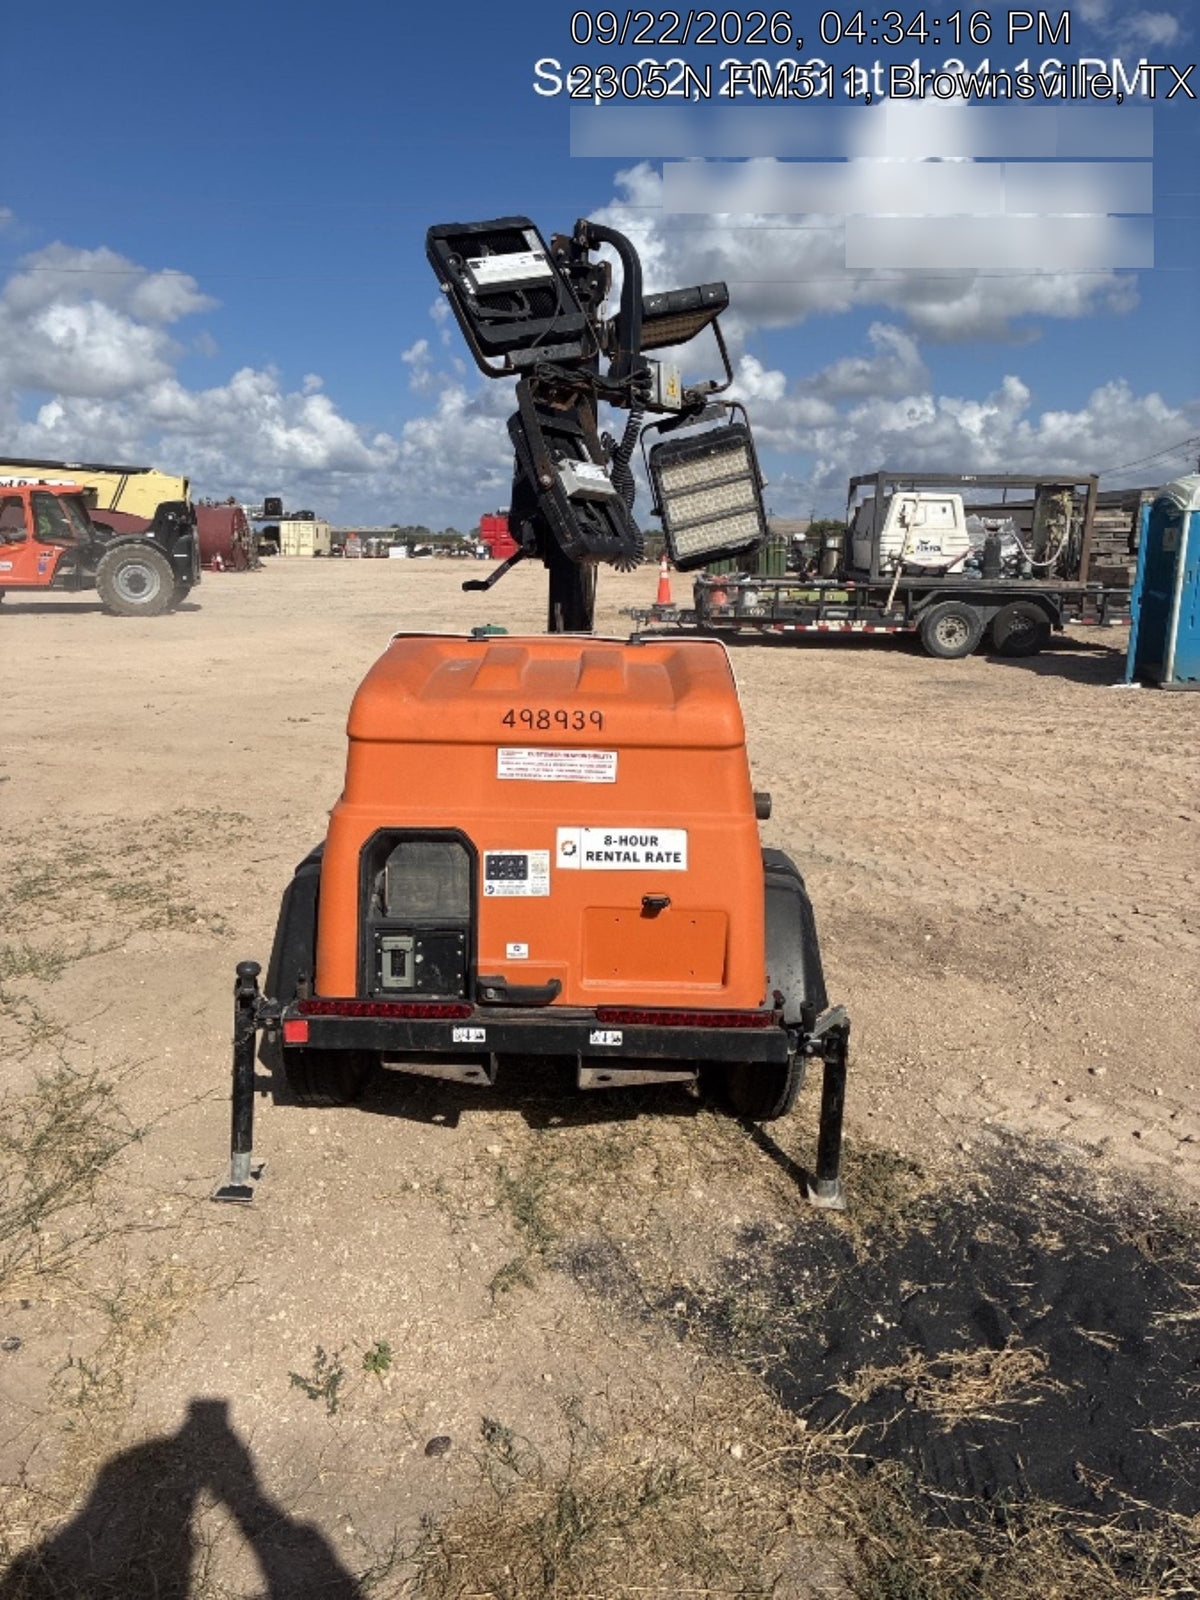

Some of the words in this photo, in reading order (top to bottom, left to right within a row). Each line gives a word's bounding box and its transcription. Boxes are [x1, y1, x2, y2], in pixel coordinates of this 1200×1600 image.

[502, 708, 605, 732] 498939
[603, 835, 659, 847] 8-HOUR
[586, 851, 641, 863] RENTAL
[645, 852, 682, 863] RATE
